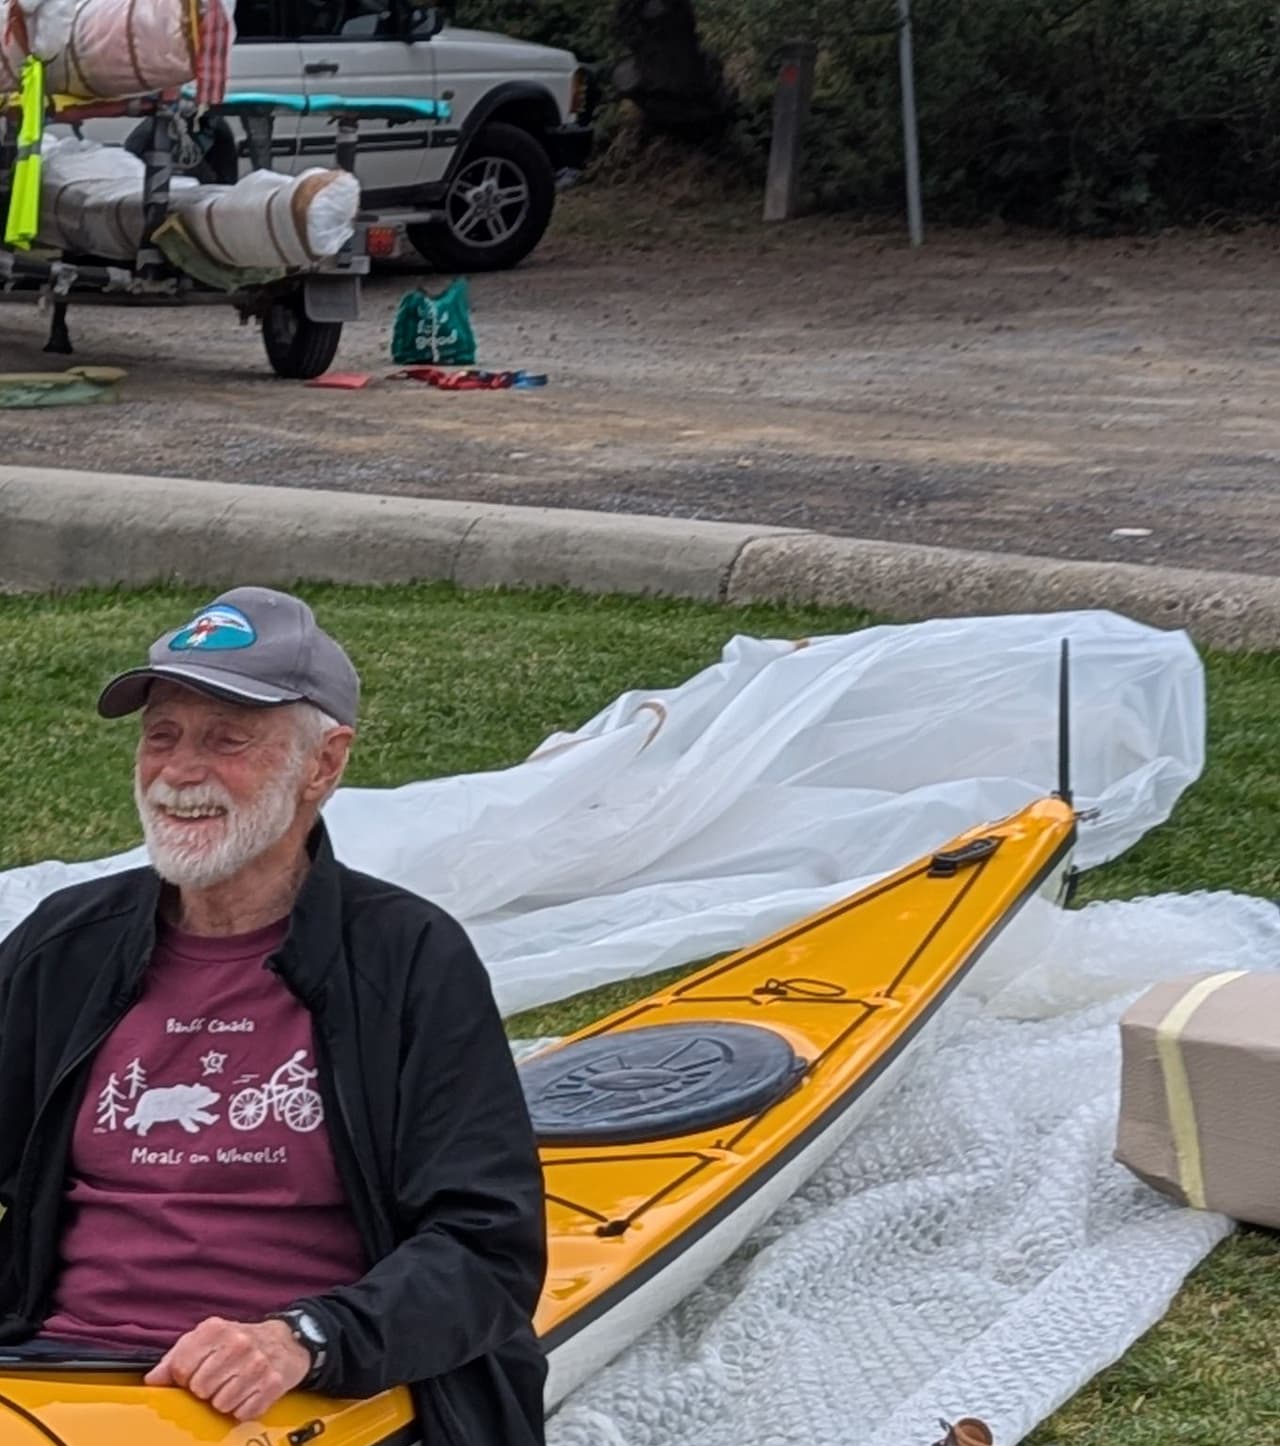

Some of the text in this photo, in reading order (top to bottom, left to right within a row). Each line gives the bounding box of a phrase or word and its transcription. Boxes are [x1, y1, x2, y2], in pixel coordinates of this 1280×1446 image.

[165, 1017, 255, 1033] Banff Canada
[130, 1146, 288, 1164] Meals on Wheels!
